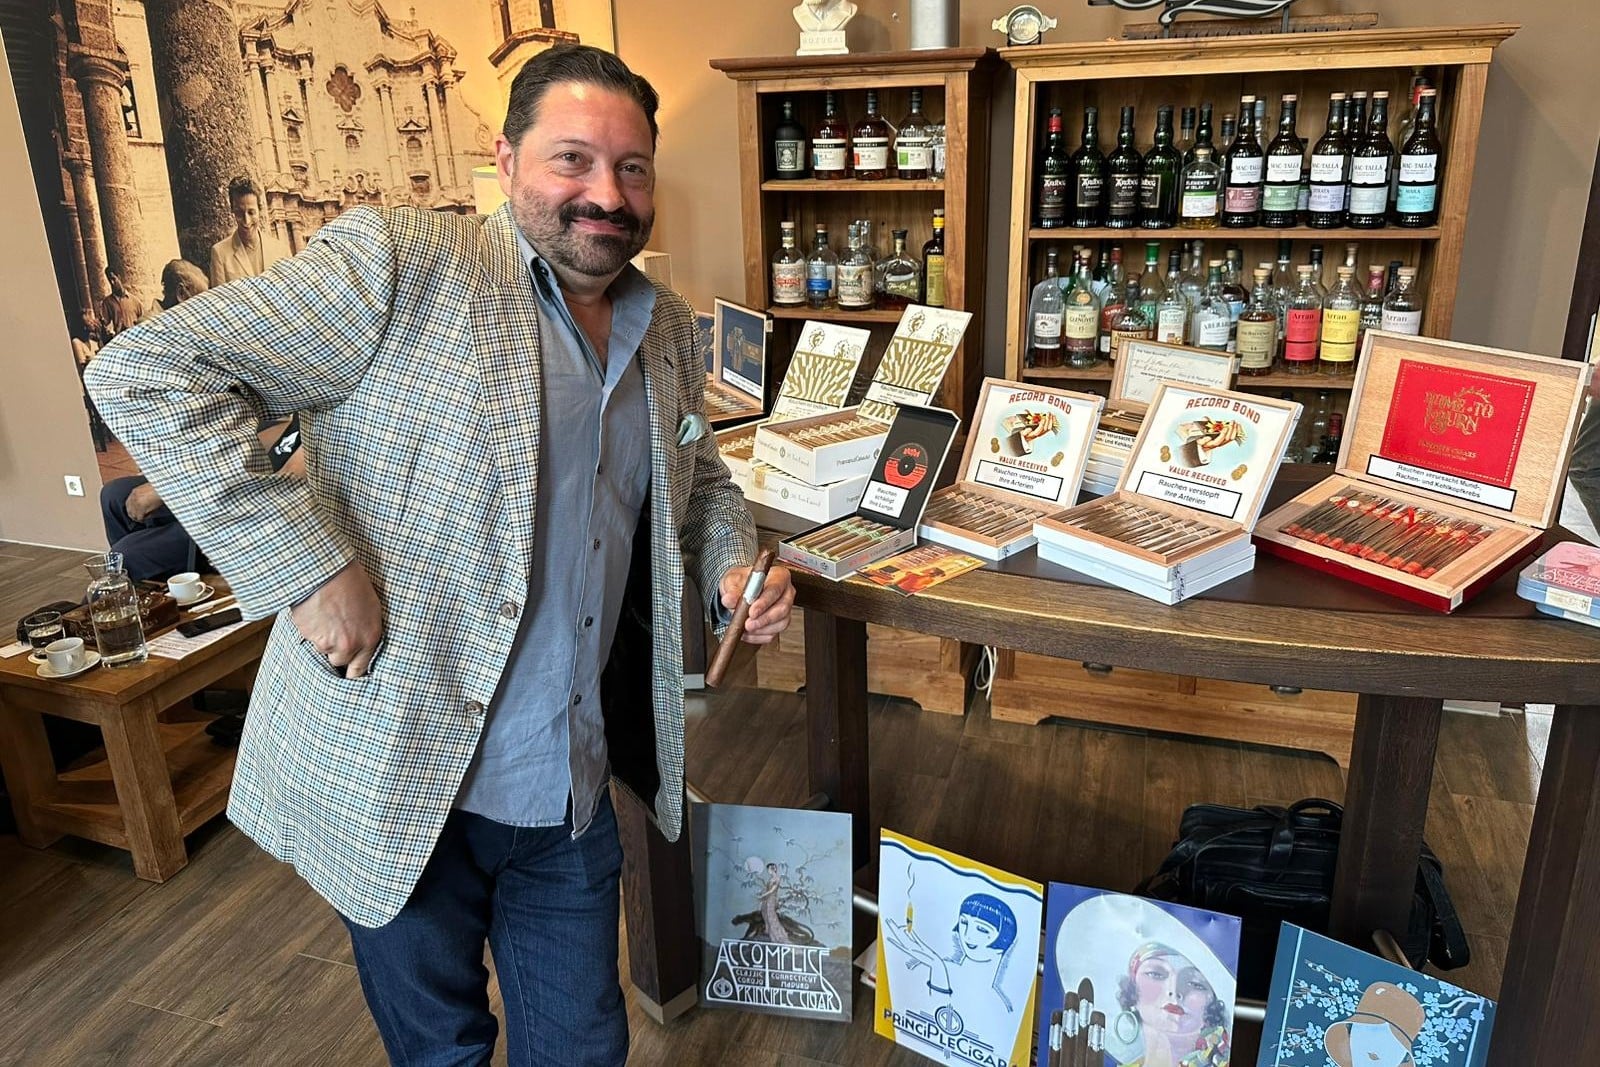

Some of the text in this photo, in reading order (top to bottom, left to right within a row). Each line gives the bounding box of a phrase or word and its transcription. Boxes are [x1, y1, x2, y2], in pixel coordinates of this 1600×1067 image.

[1385, 313, 1408, 322] Arran
[1008, 391, 1072, 415] RECORD BOND
[1185, 397, 1261, 424] RECORD BOND
[998, 456, 1049, 473] VALUE RECEIVED
[993, 466, 1046, 484] Rauchen verstopft
[1168, 465, 1228, 486] VALUE RECEIVED
[1397, 464, 1425, 476] Rauchen
[1425, 472, 1459, 485] verursacht
[998, 477, 1034, 490] Ihre Arterien
[1158, 478, 1221, 500] Rauchen verstopft
[1395, 471, 1421, 482] Rachen-
[1434, 482, 1481, 498] Kehlkopfkrebs
[1164, 489, 1206, 505] Ihre Arterien
[735, 968, 764, 979] CLASSIC
[737, 976, 764, 986] COROJO
[770, 971, 817, 984] CONNECTICUT
[780, 980, 810, 990] MADURO
[737, 984, 796, 1008] PRINCIPLE
